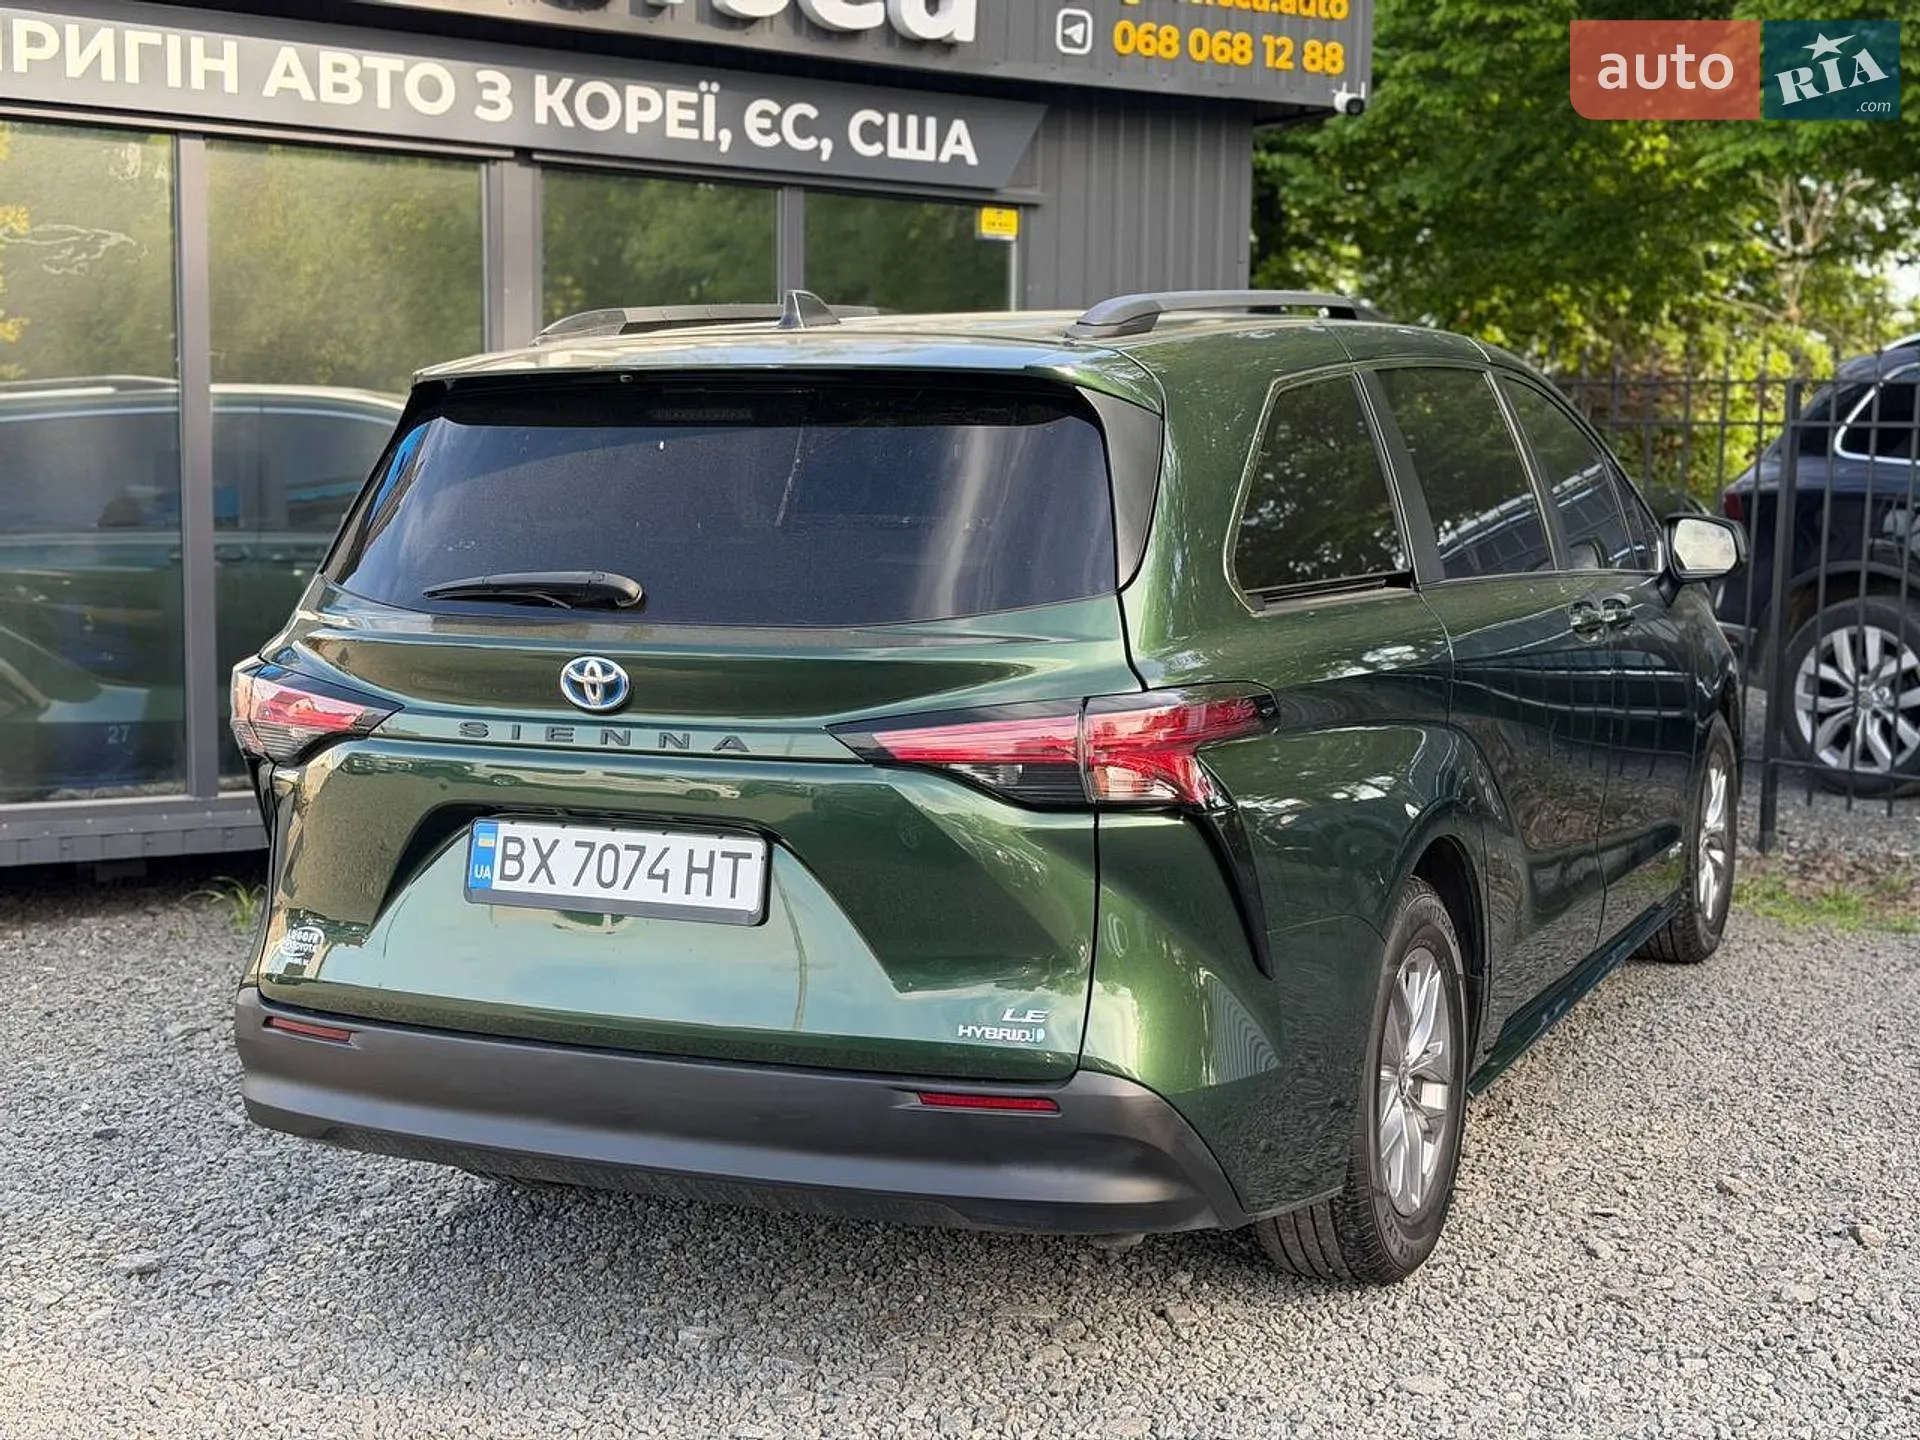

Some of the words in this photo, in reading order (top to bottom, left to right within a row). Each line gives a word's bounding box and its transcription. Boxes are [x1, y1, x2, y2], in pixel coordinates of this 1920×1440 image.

[1113, 20, 1181, 60] 068
[1188, 27, 1253, 66] 068
[1262, 35, 1295, 71] 12
[1302, 40, 1346, 76] 88
[0, 18, 239, 94] РИГІН
[262, 46, 456, 114] АВТО
[533, 74, 733, 153] КОРЕЇ,
[743, 98, 834, 162] ЄС,
[847, 109, 980, 167] США
[459, 721, 751, 752] SIENNA
[474, 864, 493, 880] UA
[500, 836, 560, 885] BX
[572, 841, 671, 894] 7074
[685, 848, 753, 899] HT
[1001, 1007, 1049, 1023] LE
[957, 1024, 1032, 1042] HYBRID
